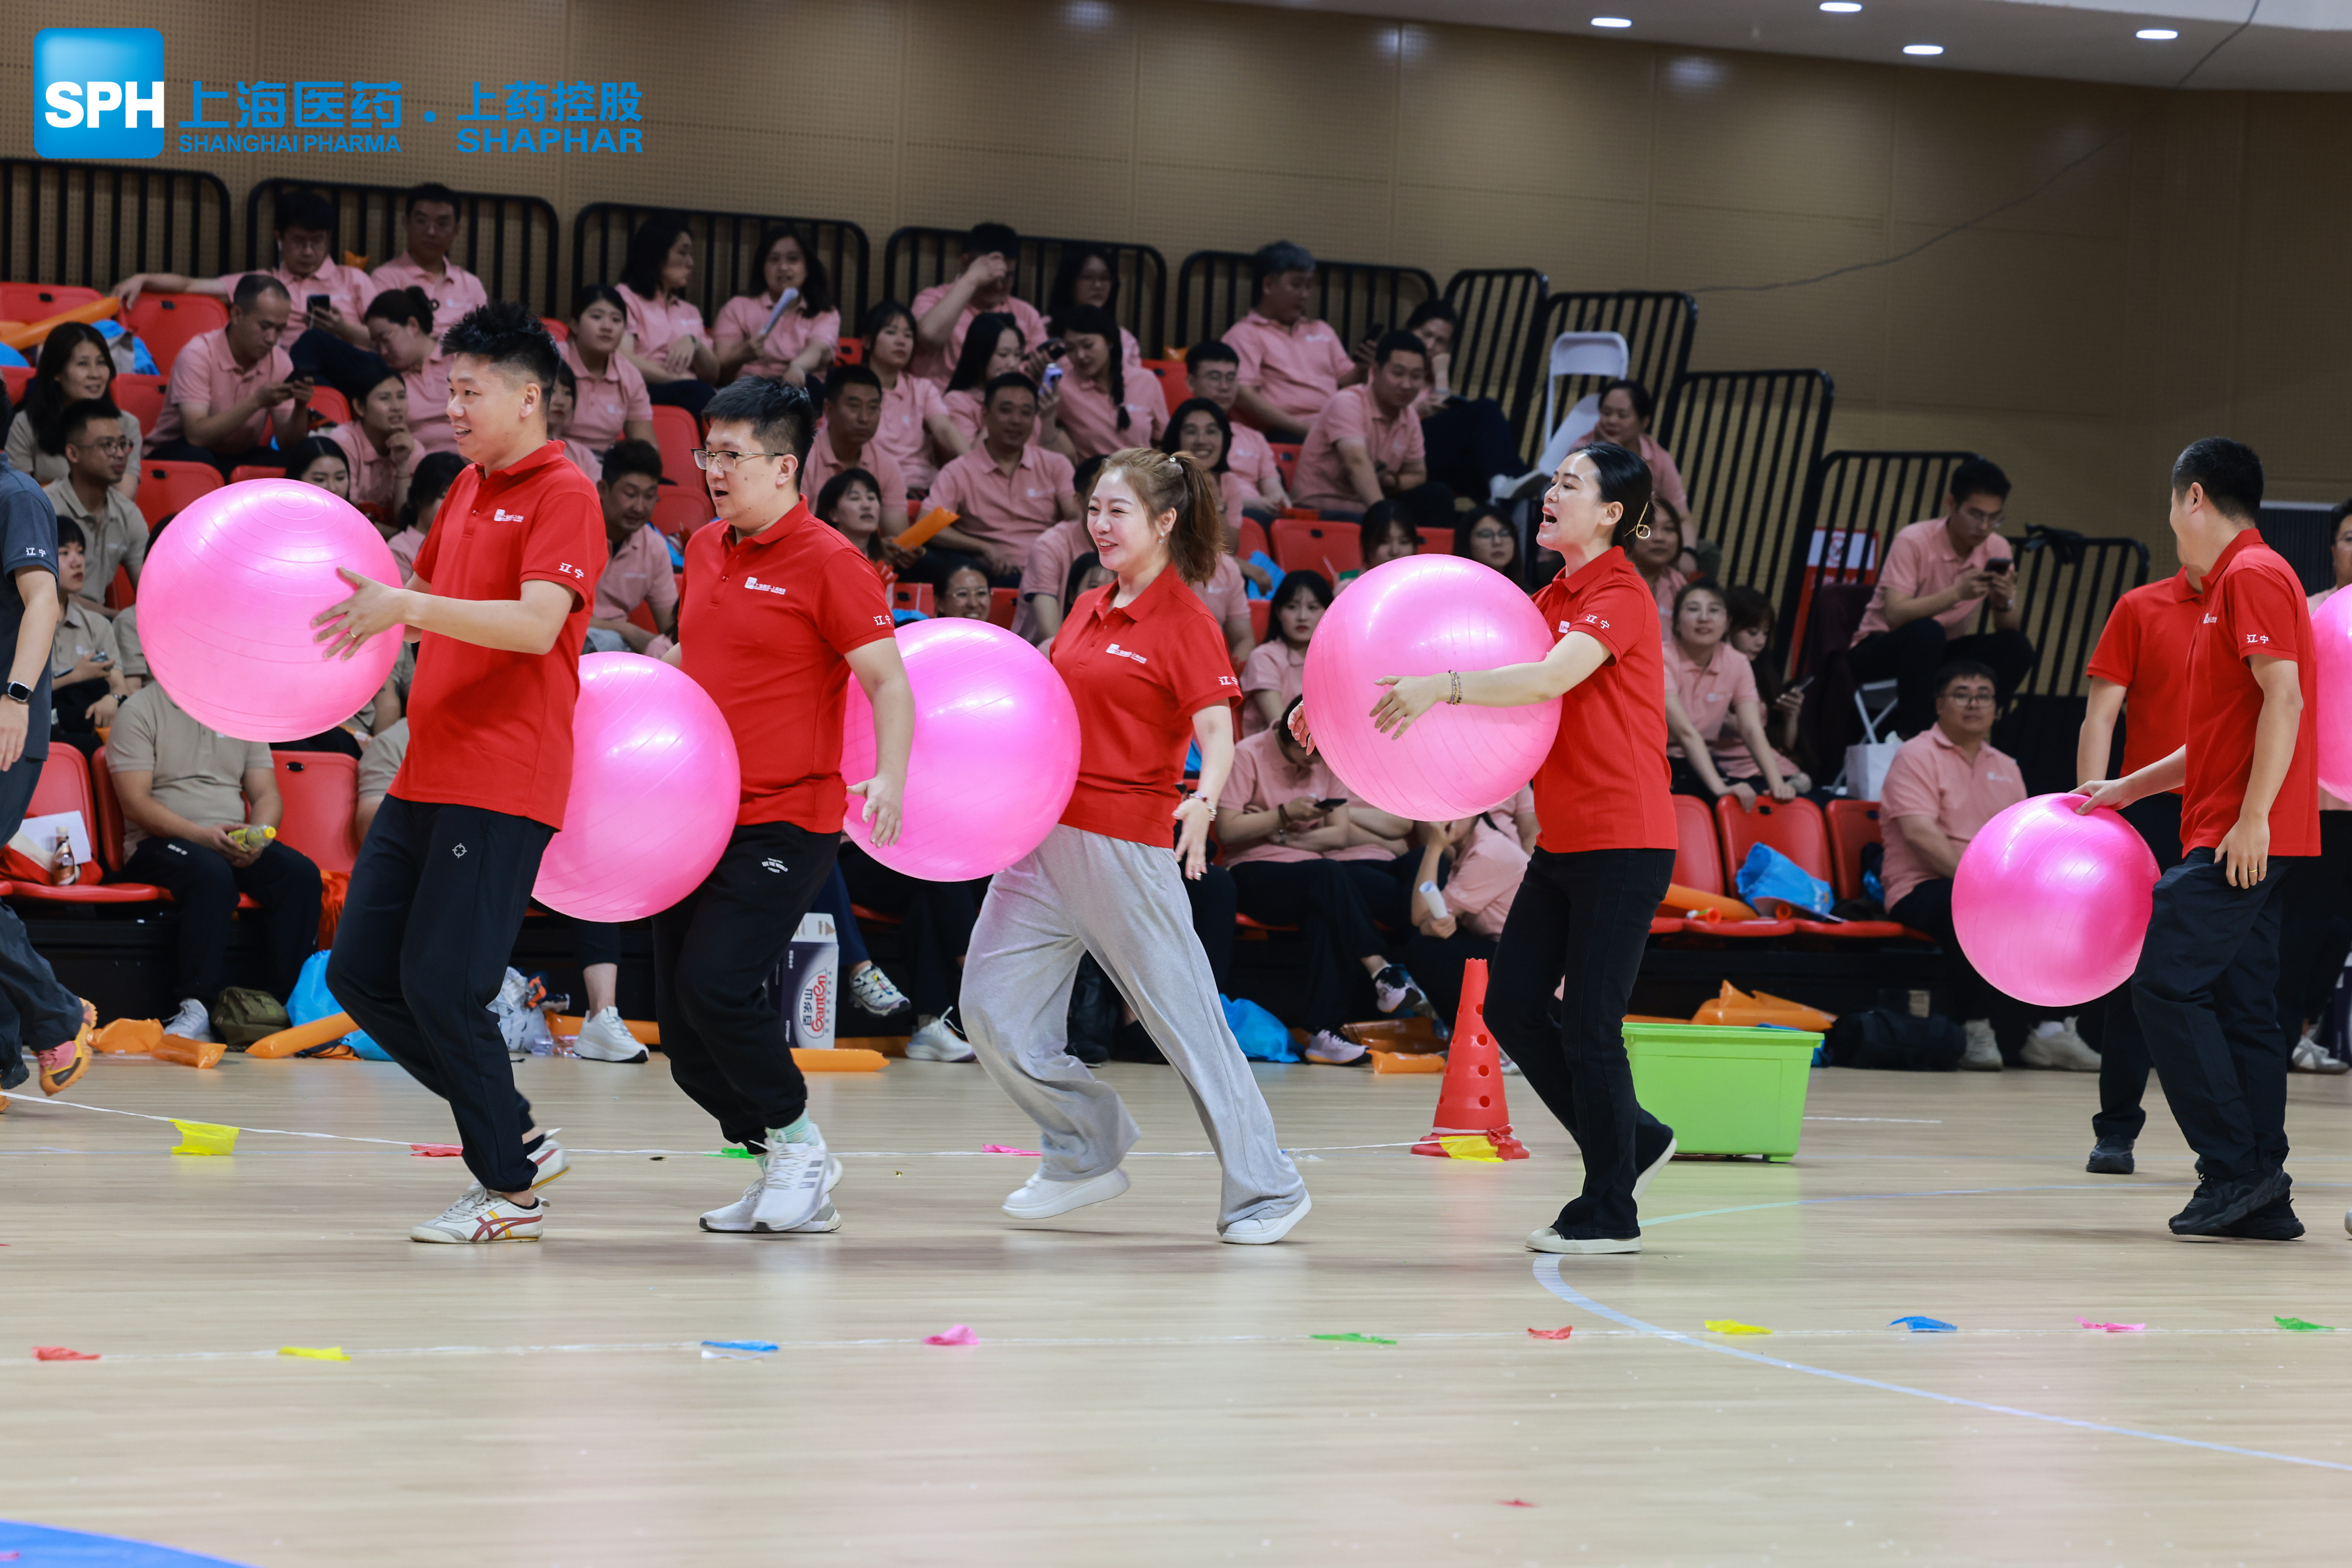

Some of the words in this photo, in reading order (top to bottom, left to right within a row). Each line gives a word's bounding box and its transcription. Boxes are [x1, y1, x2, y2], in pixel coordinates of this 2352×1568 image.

[26, 547, 46, 557] 辽宁
[559, 562, 584, 579] 辽宁
[1585, 614, 1610, 629] 辽宁
[2246, 634, 2269, 644] 辽宁
